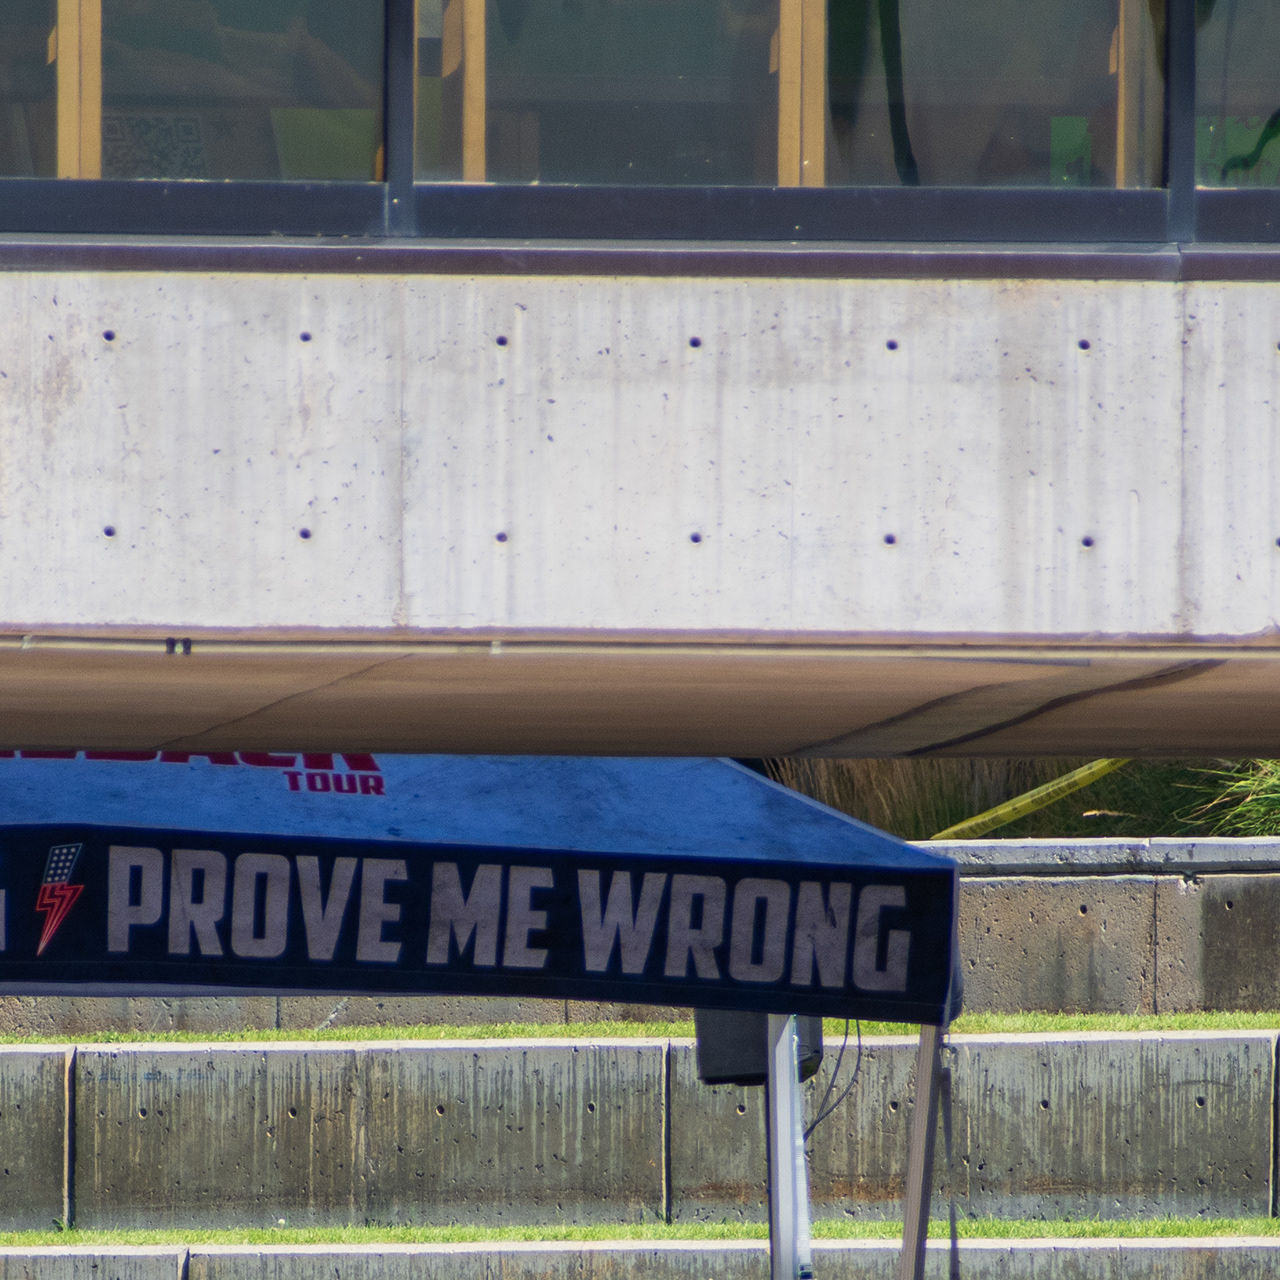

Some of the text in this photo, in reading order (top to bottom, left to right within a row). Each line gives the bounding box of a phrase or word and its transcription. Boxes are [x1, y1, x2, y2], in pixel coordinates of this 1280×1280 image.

[282, 769, 385, 796] TOUR
[108, 845, 408, 962] PROVE
[426, 862, 554, 968] ME
[577, 868, 910, 992] WRONG
